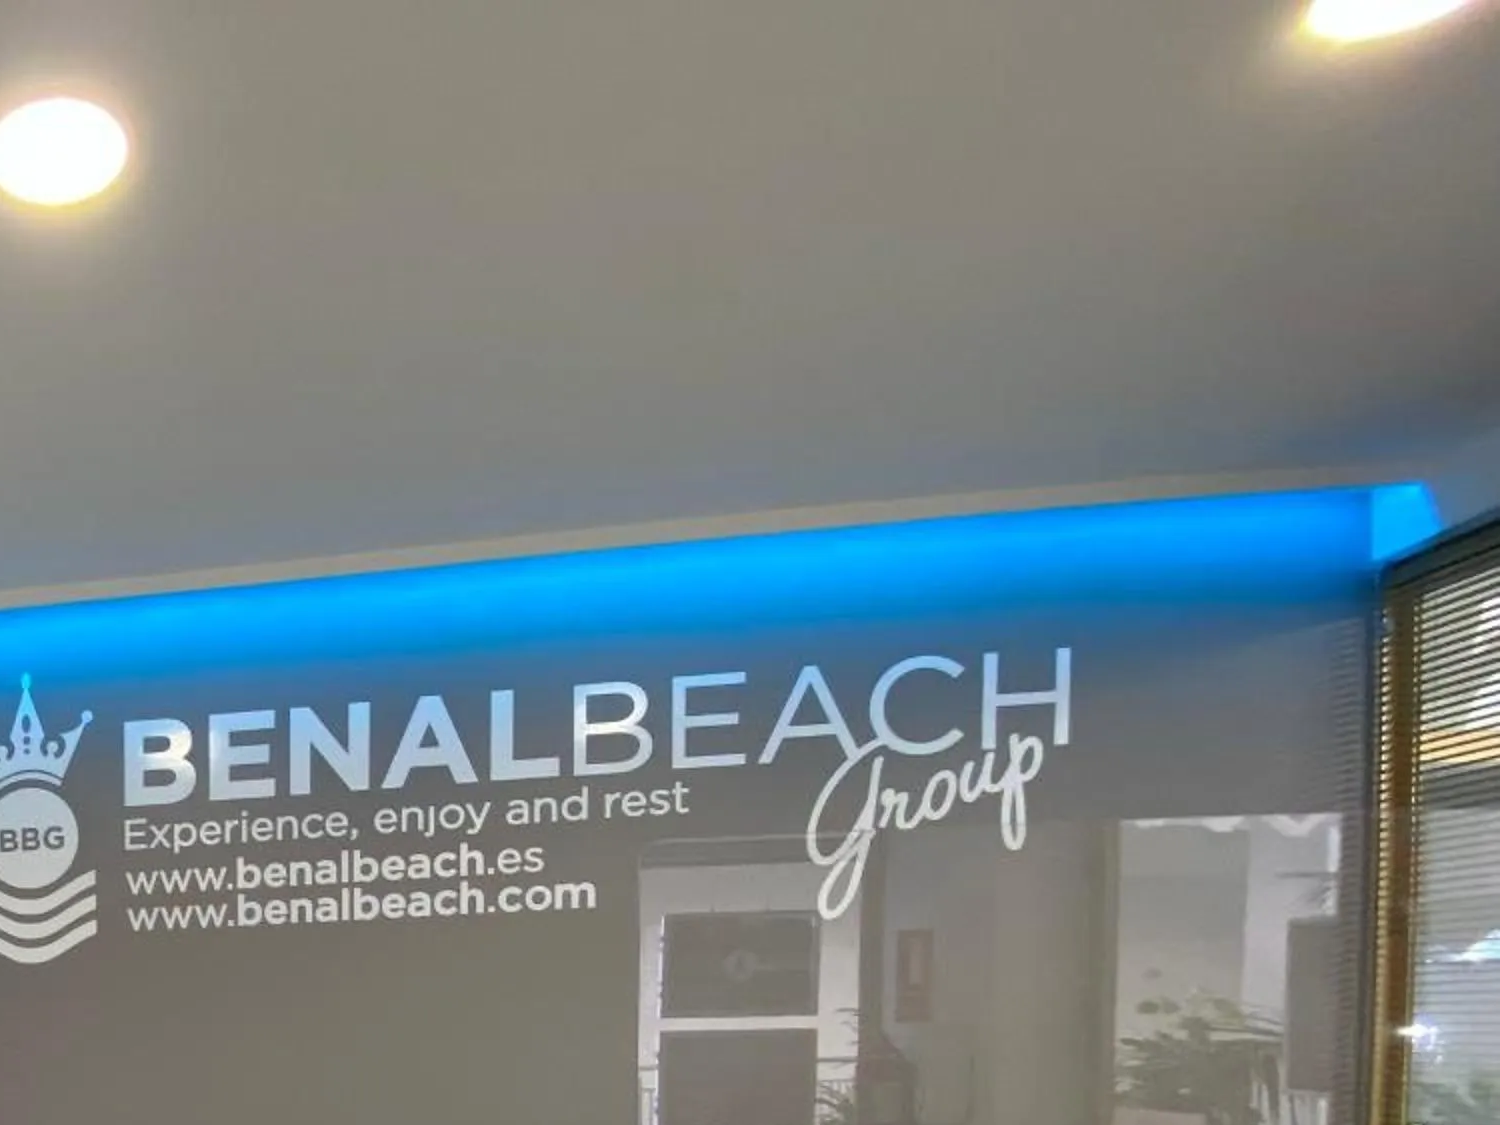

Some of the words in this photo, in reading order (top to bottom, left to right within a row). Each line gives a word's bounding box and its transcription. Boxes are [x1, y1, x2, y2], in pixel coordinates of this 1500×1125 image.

[123, 647, 1071, 807] BENALBEACH
[123, 810, 359, 853] Experience,
[373, 801, 492, 837] enjoy
[505, 786, 589, 825] and
[603, 781, 690, 818] rest
[125, 841, 545, 895] www.benalbeach.es
[127, 880, 597, 931] www.benalbeach.com
